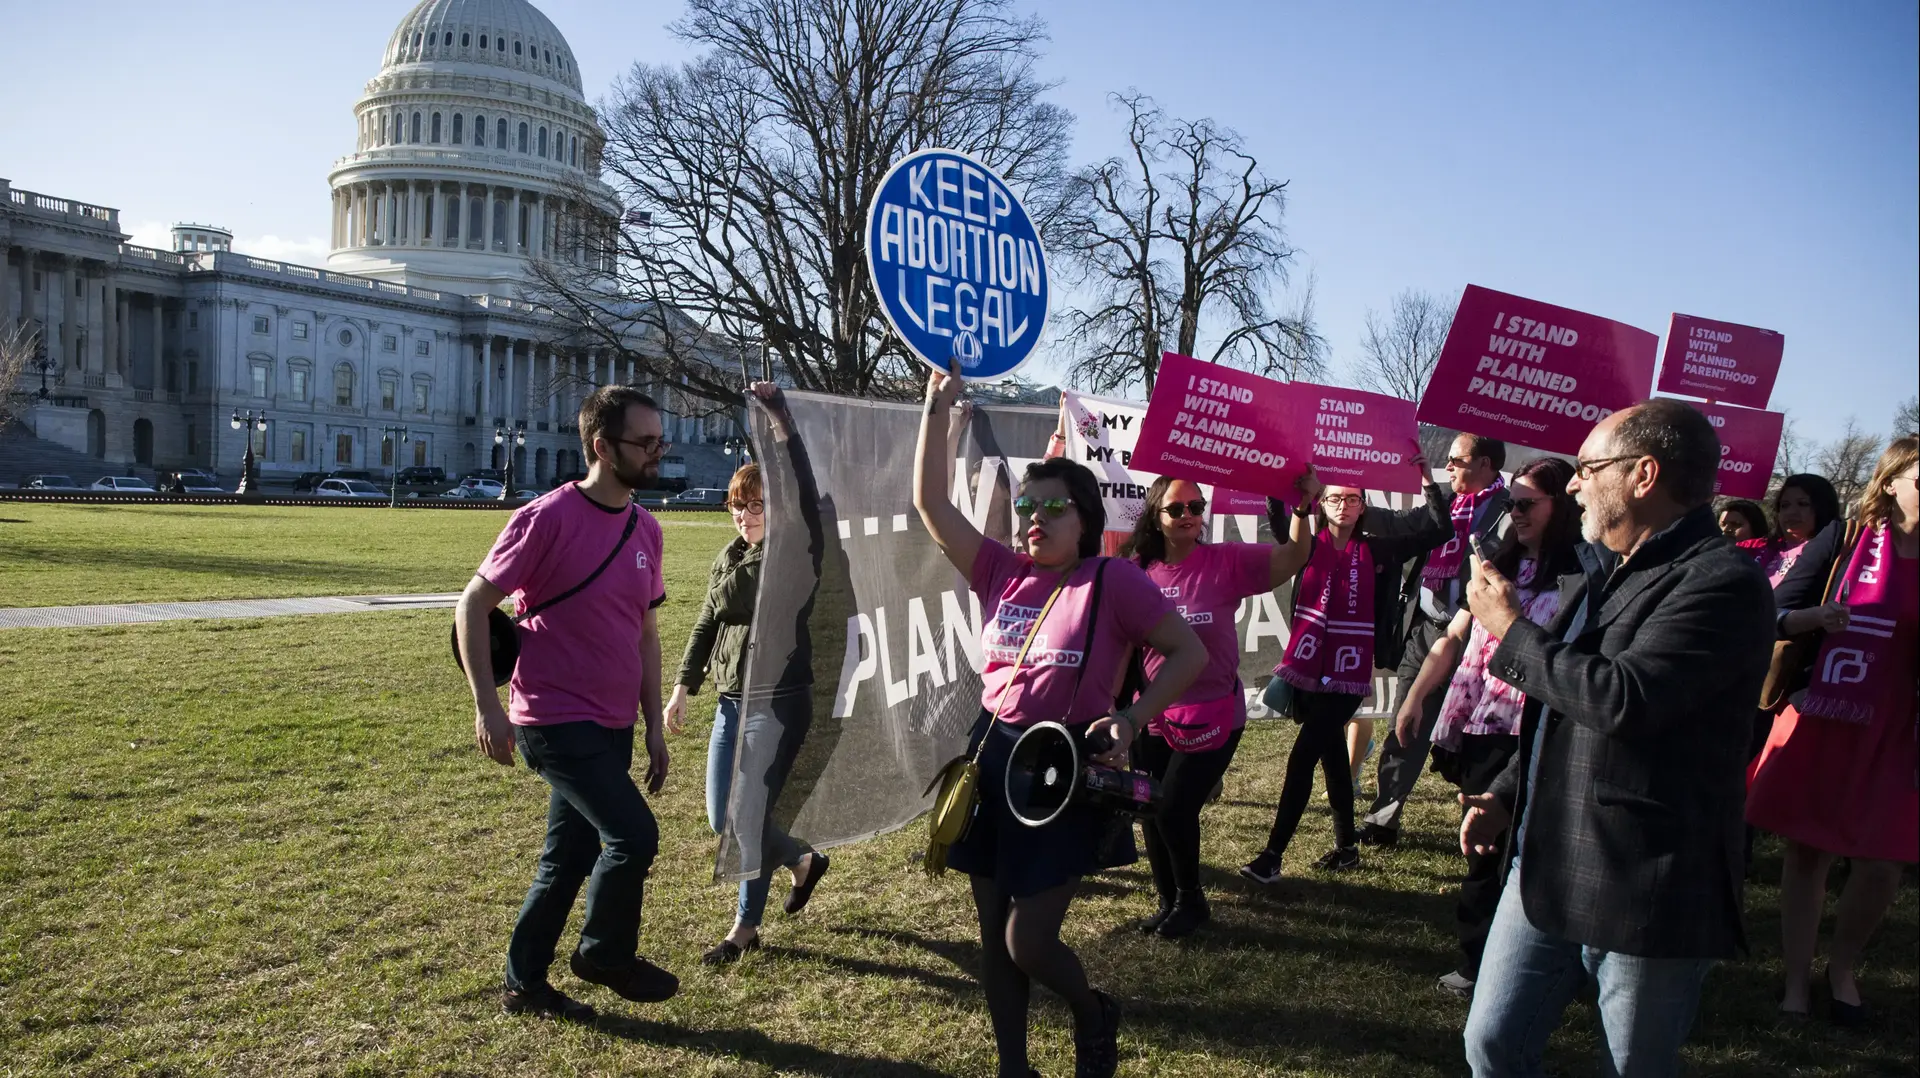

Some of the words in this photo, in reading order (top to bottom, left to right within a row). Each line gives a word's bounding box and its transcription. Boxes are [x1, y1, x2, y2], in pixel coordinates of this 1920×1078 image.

[909, 159, 1012, 226] KEEP
[880, 202, 1040, 296] ABORTION
[898, 268, 1029, 347] LEGAL
[1493, 312, 1504, 330] I
[1505, 316, 1579, 347] STAND
[1690, 327, 1695, 336] I
[1696, 328, 1733, 343] STAND
[1488, 334, 1547, 363] WITH
[1688, 339, 1718, 353] WITH
[1685, 351, 1737, 369] PLANNED
[1476, 355, 1577, 393] PLANNED
[1683, 363, 1757, 385] PARENTHOOD
[1188, 375, 1196, 390] I
[1197, 378, 1254, 404] STAND
[1184, 394, 1230, 418] WITH
[1320, 398, 1365, 415] STAND
[1467, 405, 1500, 421] Planned
[1500, 413, 1546, 431] Parenthood
[1102, 413, 1133, 430] MY
[1174, 411, 1256, 443] PLANNED
[1086, 445, 1114, 463] MY
[1167, 429, 1286, 469] PARENTHOOD
[1168, 453, 1195, 467] Planned
[1195, 460, 1232, 475] Parenthood
[1333, 466, 1363, 476] Parenthood
[1100, 482, 1150, 500] THER
[1348, 568, 1359, 607] STAND
[1172, 726, 1220, 745] Volunteer
